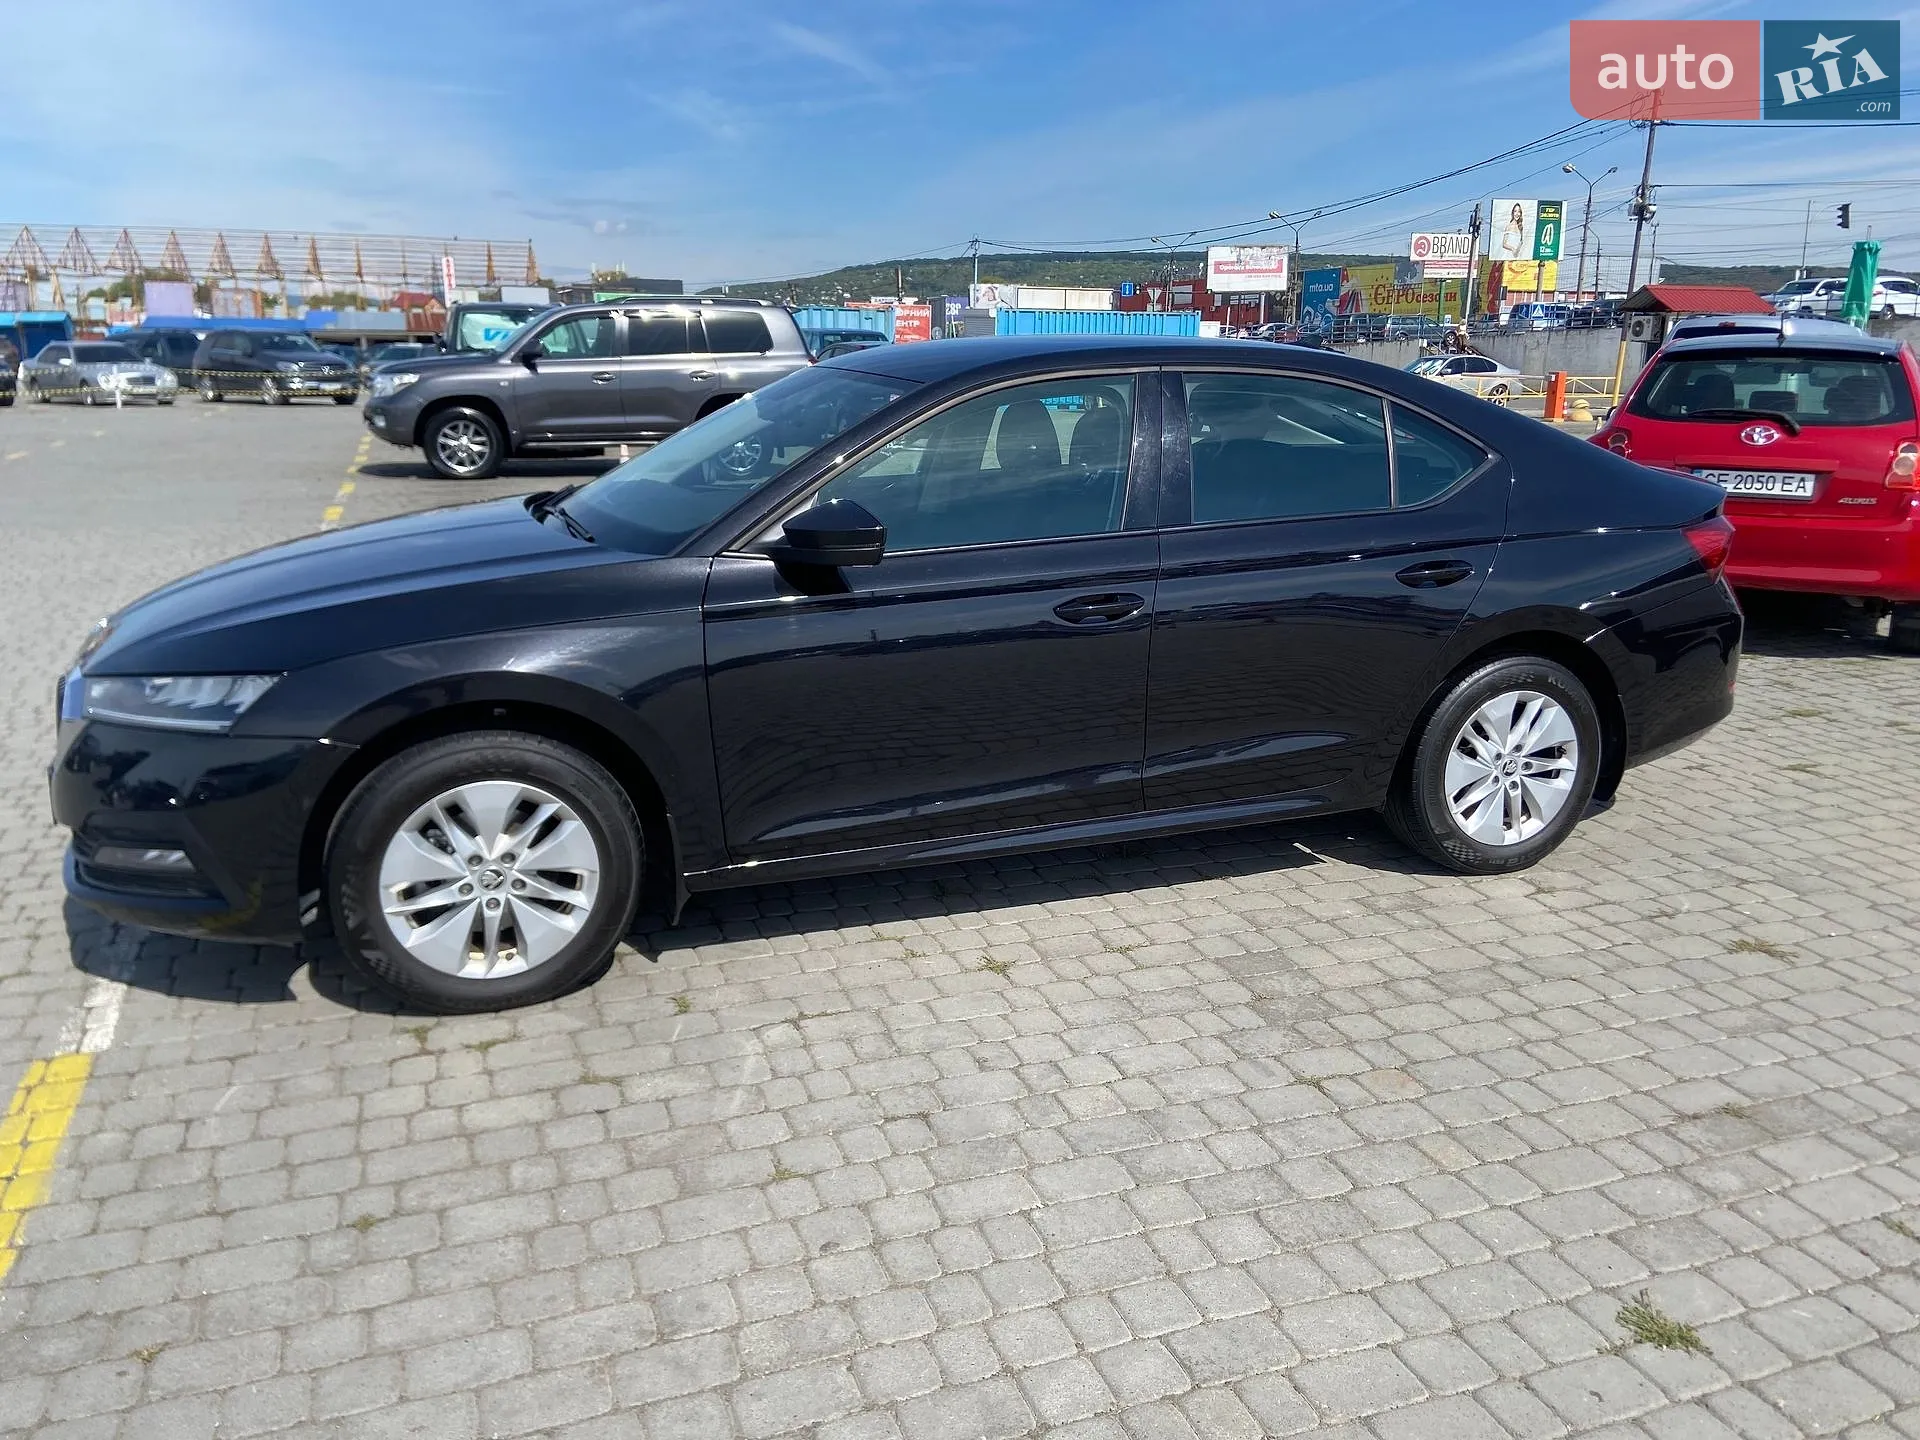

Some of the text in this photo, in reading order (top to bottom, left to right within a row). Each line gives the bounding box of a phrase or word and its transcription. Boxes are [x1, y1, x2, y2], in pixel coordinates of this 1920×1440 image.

[1432, 236, 1470, 254] BRAND
[1309, 282, 1334, 293] mta.ua
[1733, 473, 1776, 492] 2050
[1780, 475, 1807, 493] EA
